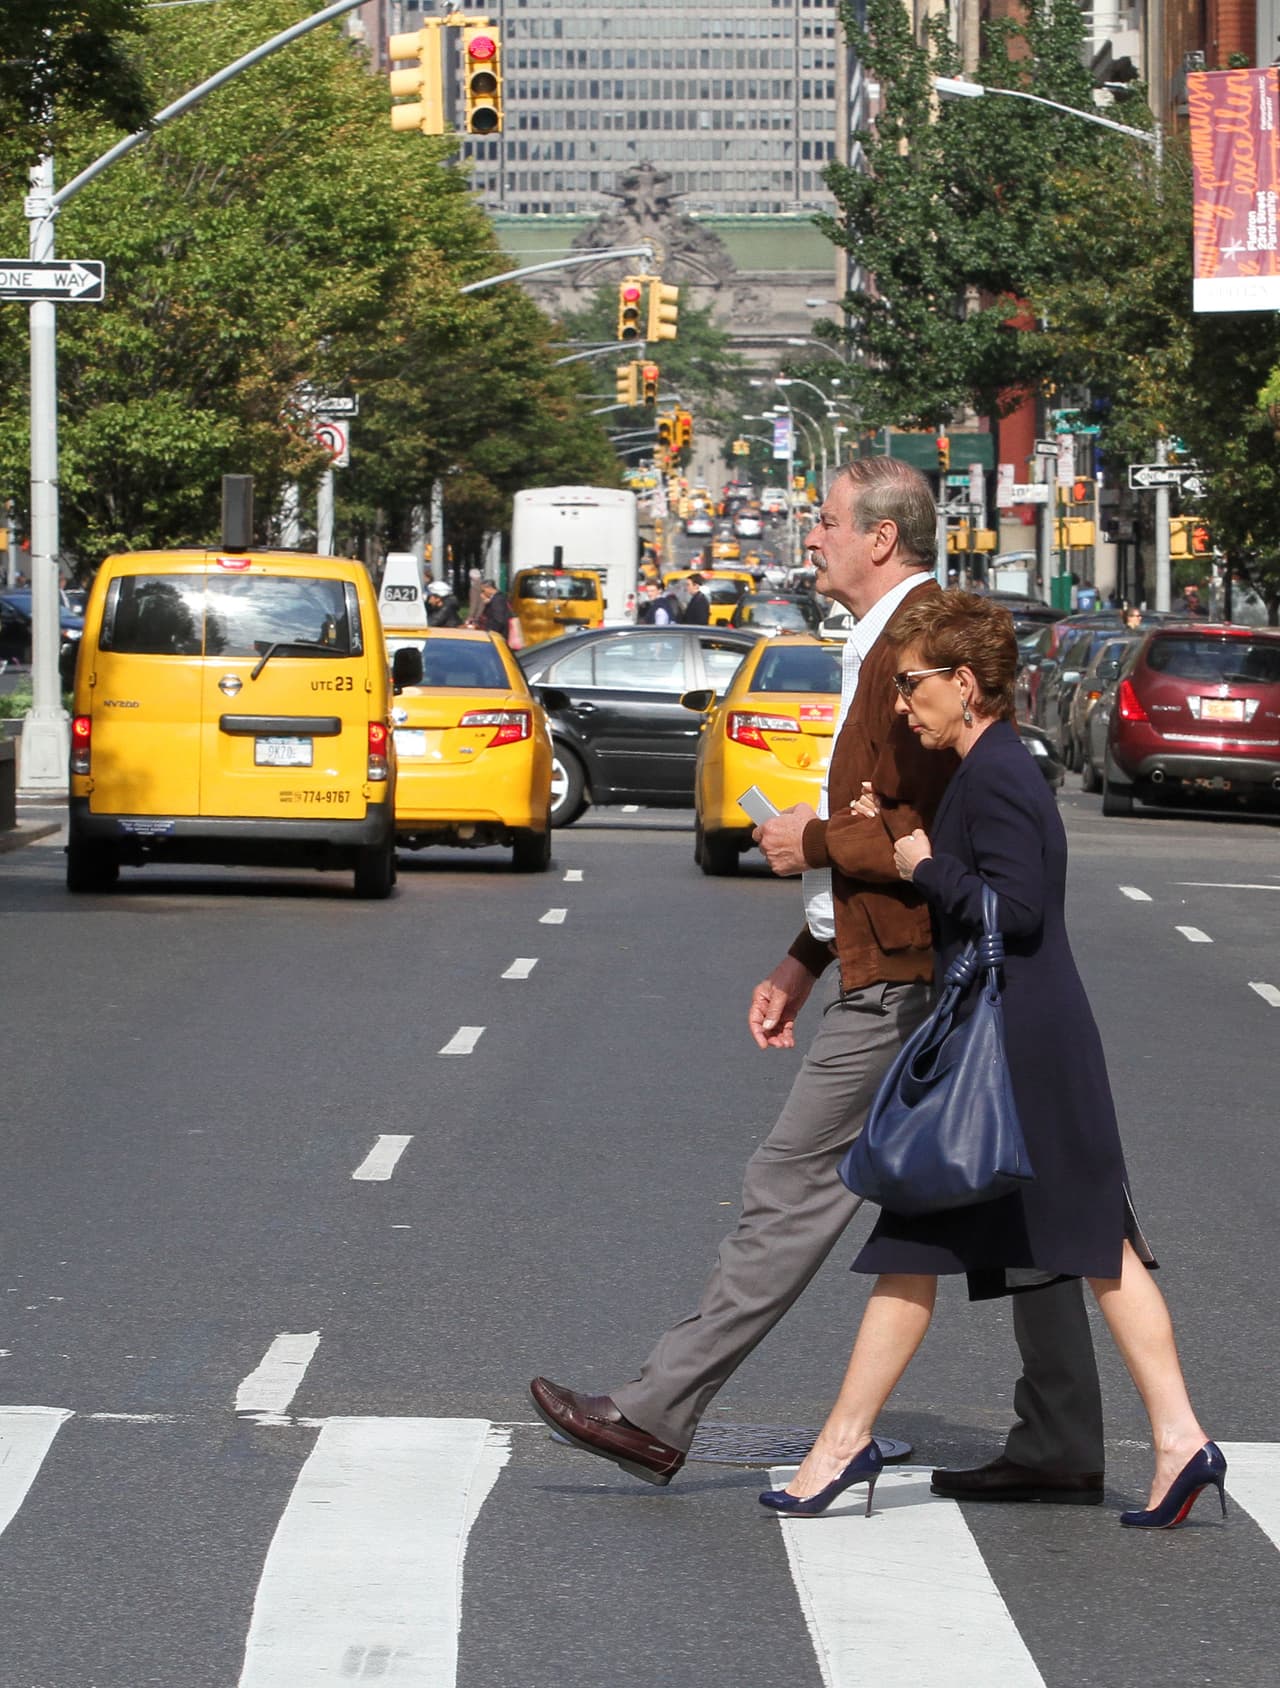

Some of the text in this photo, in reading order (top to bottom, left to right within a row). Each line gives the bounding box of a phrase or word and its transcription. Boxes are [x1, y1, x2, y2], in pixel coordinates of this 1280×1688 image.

[1256, 190, 1267, 250] 23rd Street
[1266, 190, 1280, 251] Partnership
[1246, 210, 1257, 251] Flatiron
[0, 272, 89, 287] ONE WAY
[384, 587, 416, 601] 6A21
[335, 676, 353, 691] 23
[303, 790, 350, 803] 774-9767
